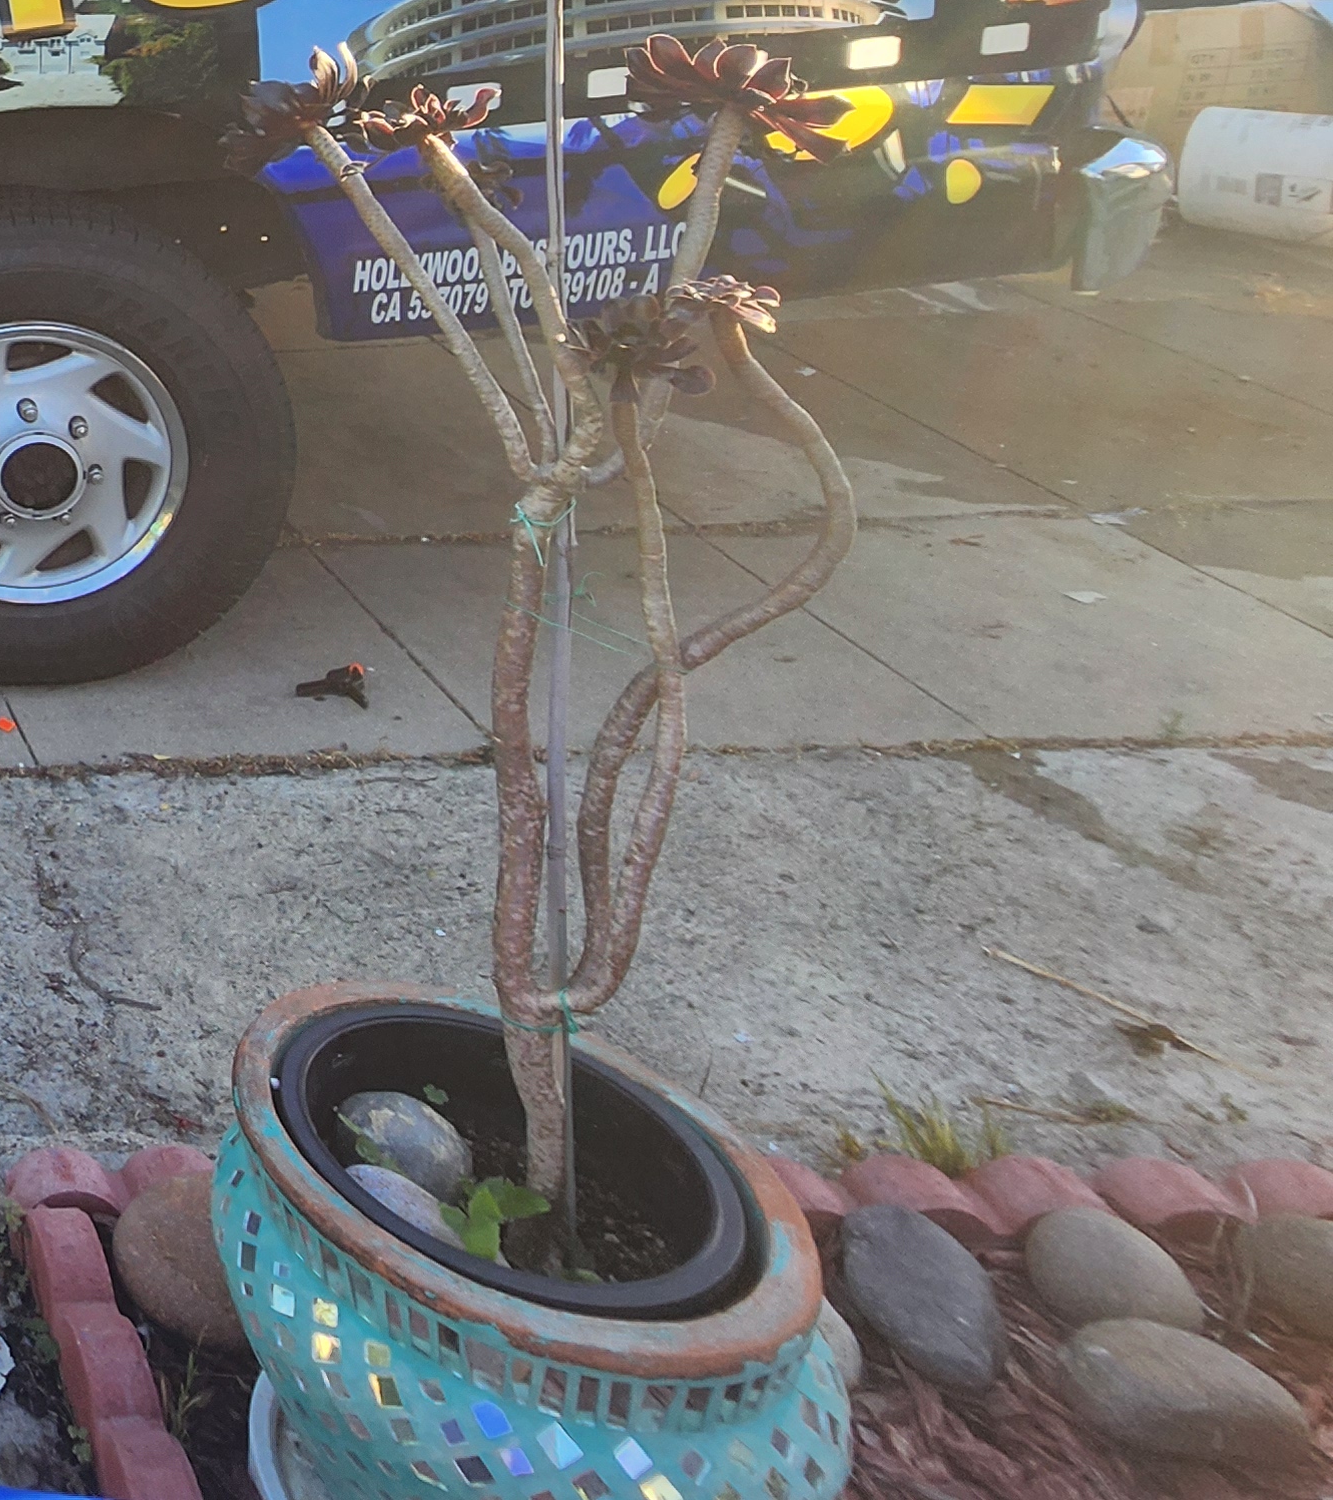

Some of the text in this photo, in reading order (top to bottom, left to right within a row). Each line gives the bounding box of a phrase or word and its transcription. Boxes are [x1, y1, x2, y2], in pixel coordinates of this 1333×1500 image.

[353, 246, 483, 294] HOLYWOO
[371, 290, 401, 325] CA
[641, 262, 659, 296] A
